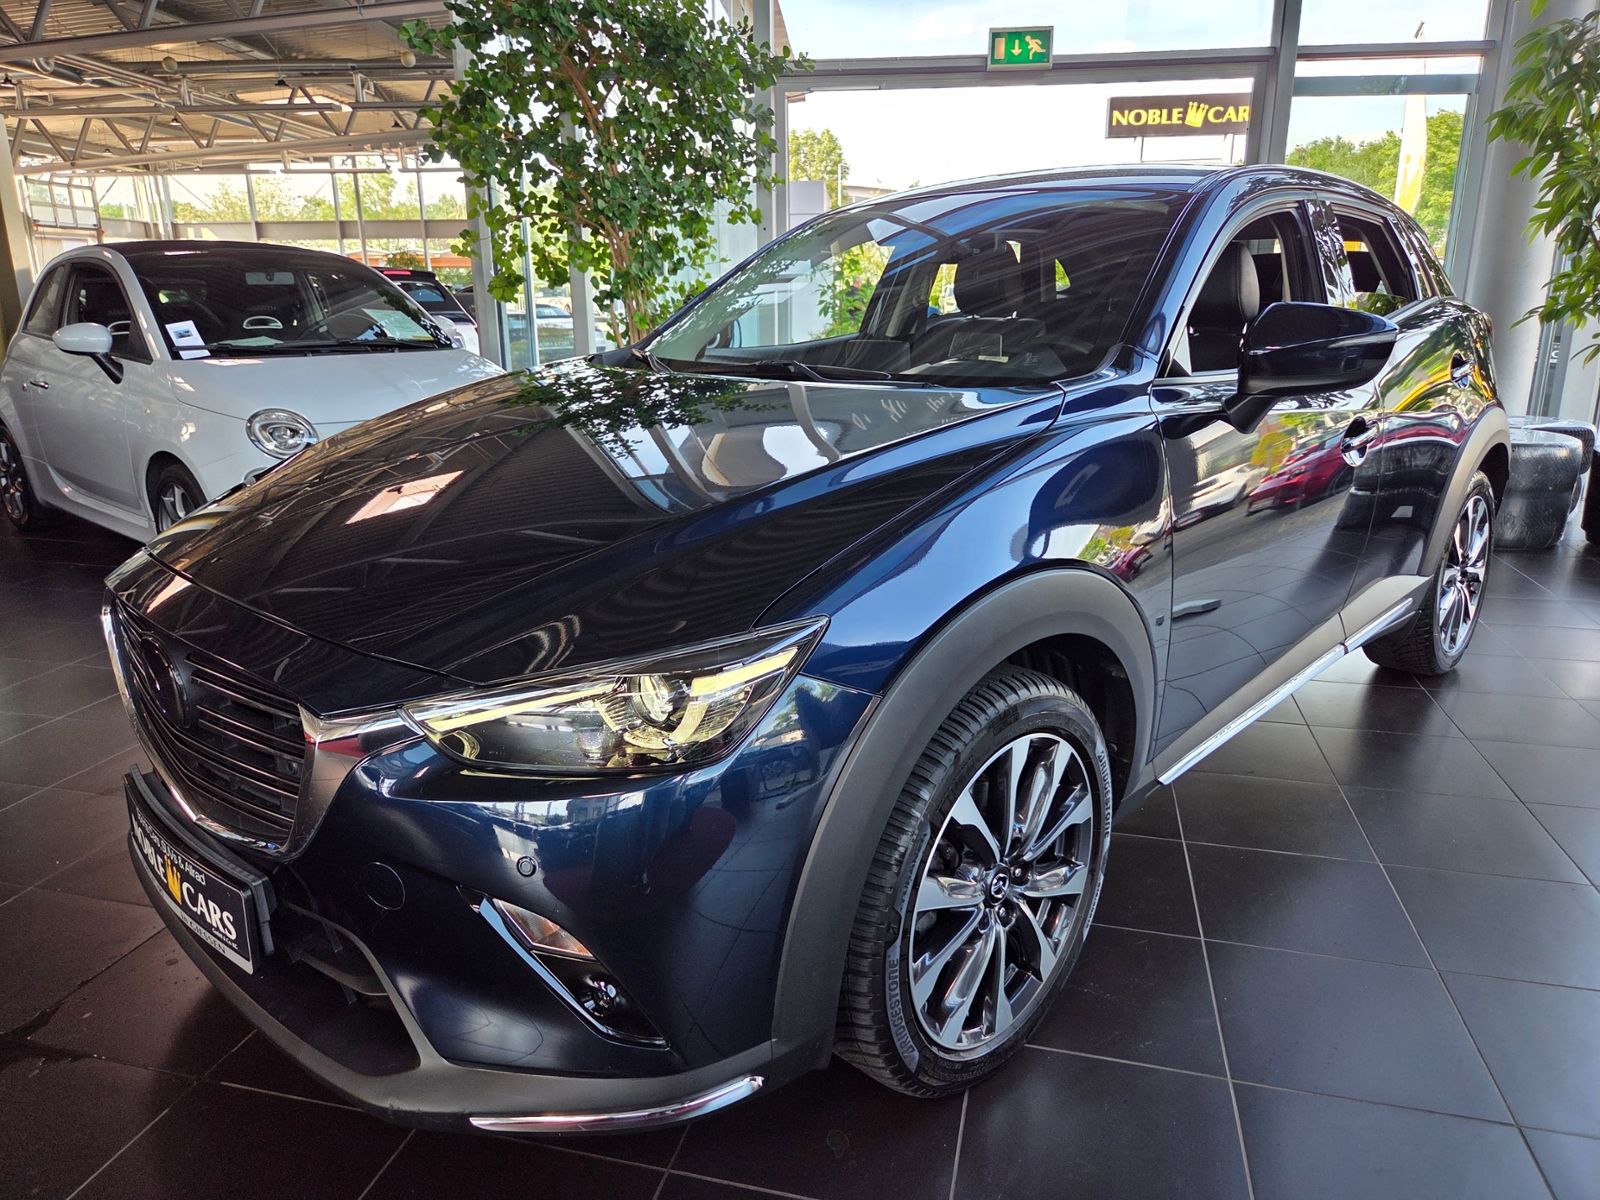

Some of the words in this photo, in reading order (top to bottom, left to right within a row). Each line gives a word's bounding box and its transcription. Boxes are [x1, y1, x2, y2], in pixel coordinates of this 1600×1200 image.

[1112, 108, 1184, 126] NOBLE
[1207, 104, 1250, 123] CAR
[185, 861, 206, 886] Allrad
[181, 881, 237, 941] CARS
[888, 958, 916, 1058] BRIDGESTONE
